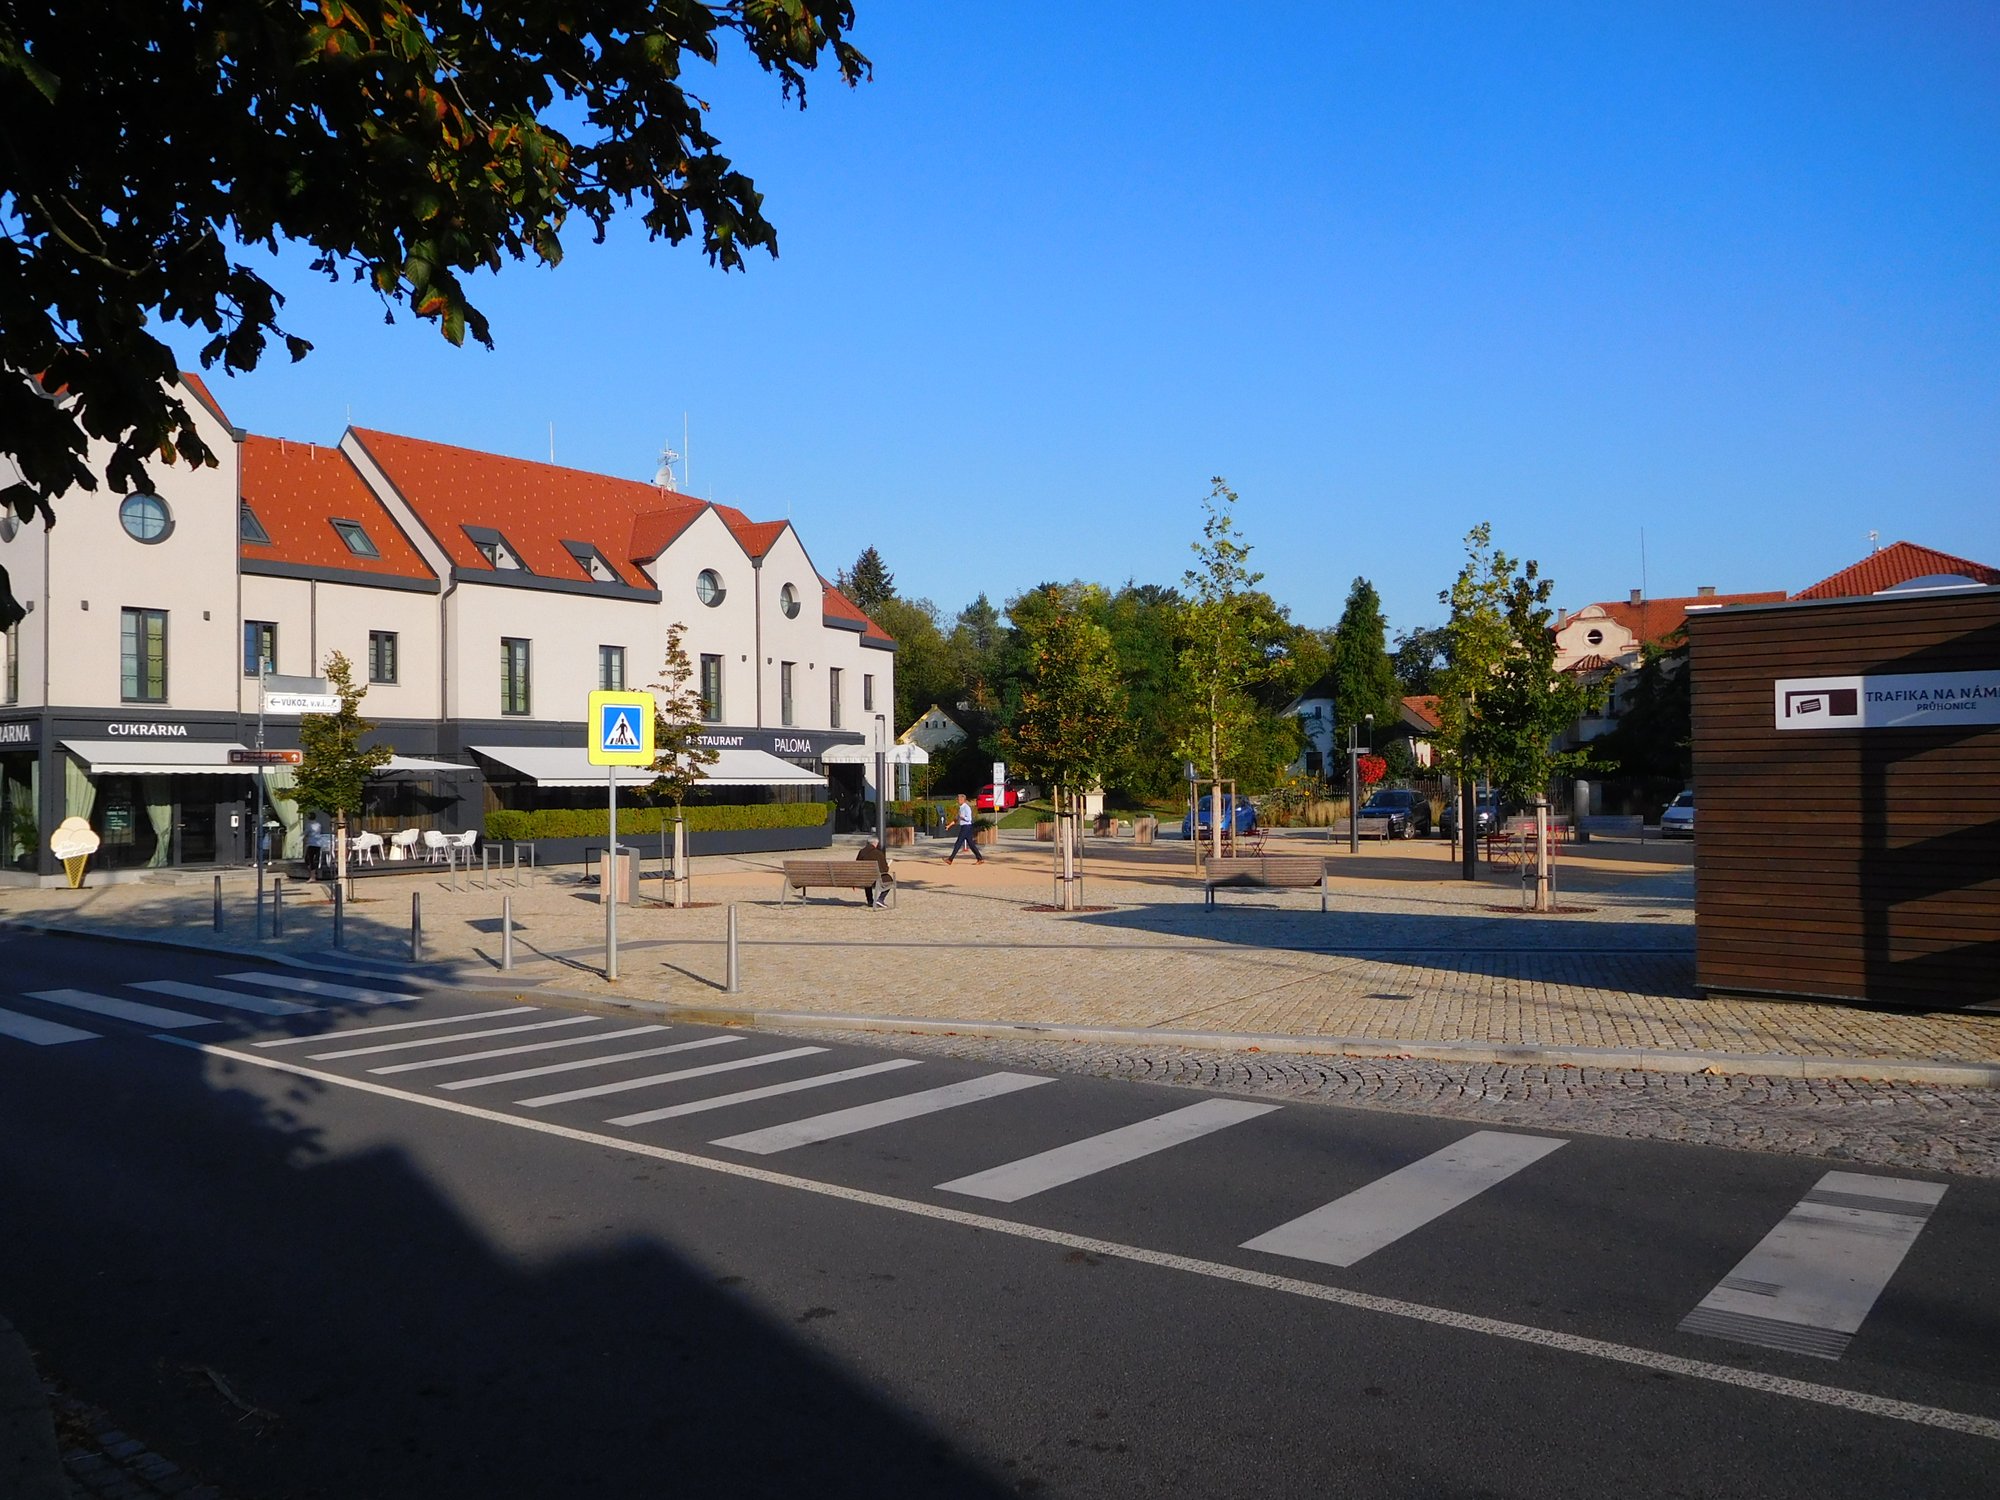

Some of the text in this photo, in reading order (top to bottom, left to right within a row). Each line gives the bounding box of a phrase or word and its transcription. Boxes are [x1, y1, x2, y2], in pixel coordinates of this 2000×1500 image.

[1865, 685, 2000, 702] TRAFIKA NA NÁM
[1916, 701, 1977, 711] PRŮHONICE
[107, 723, 188, 736] CUKRÁRNA
[774, 737, 812, 753] PALOMA
